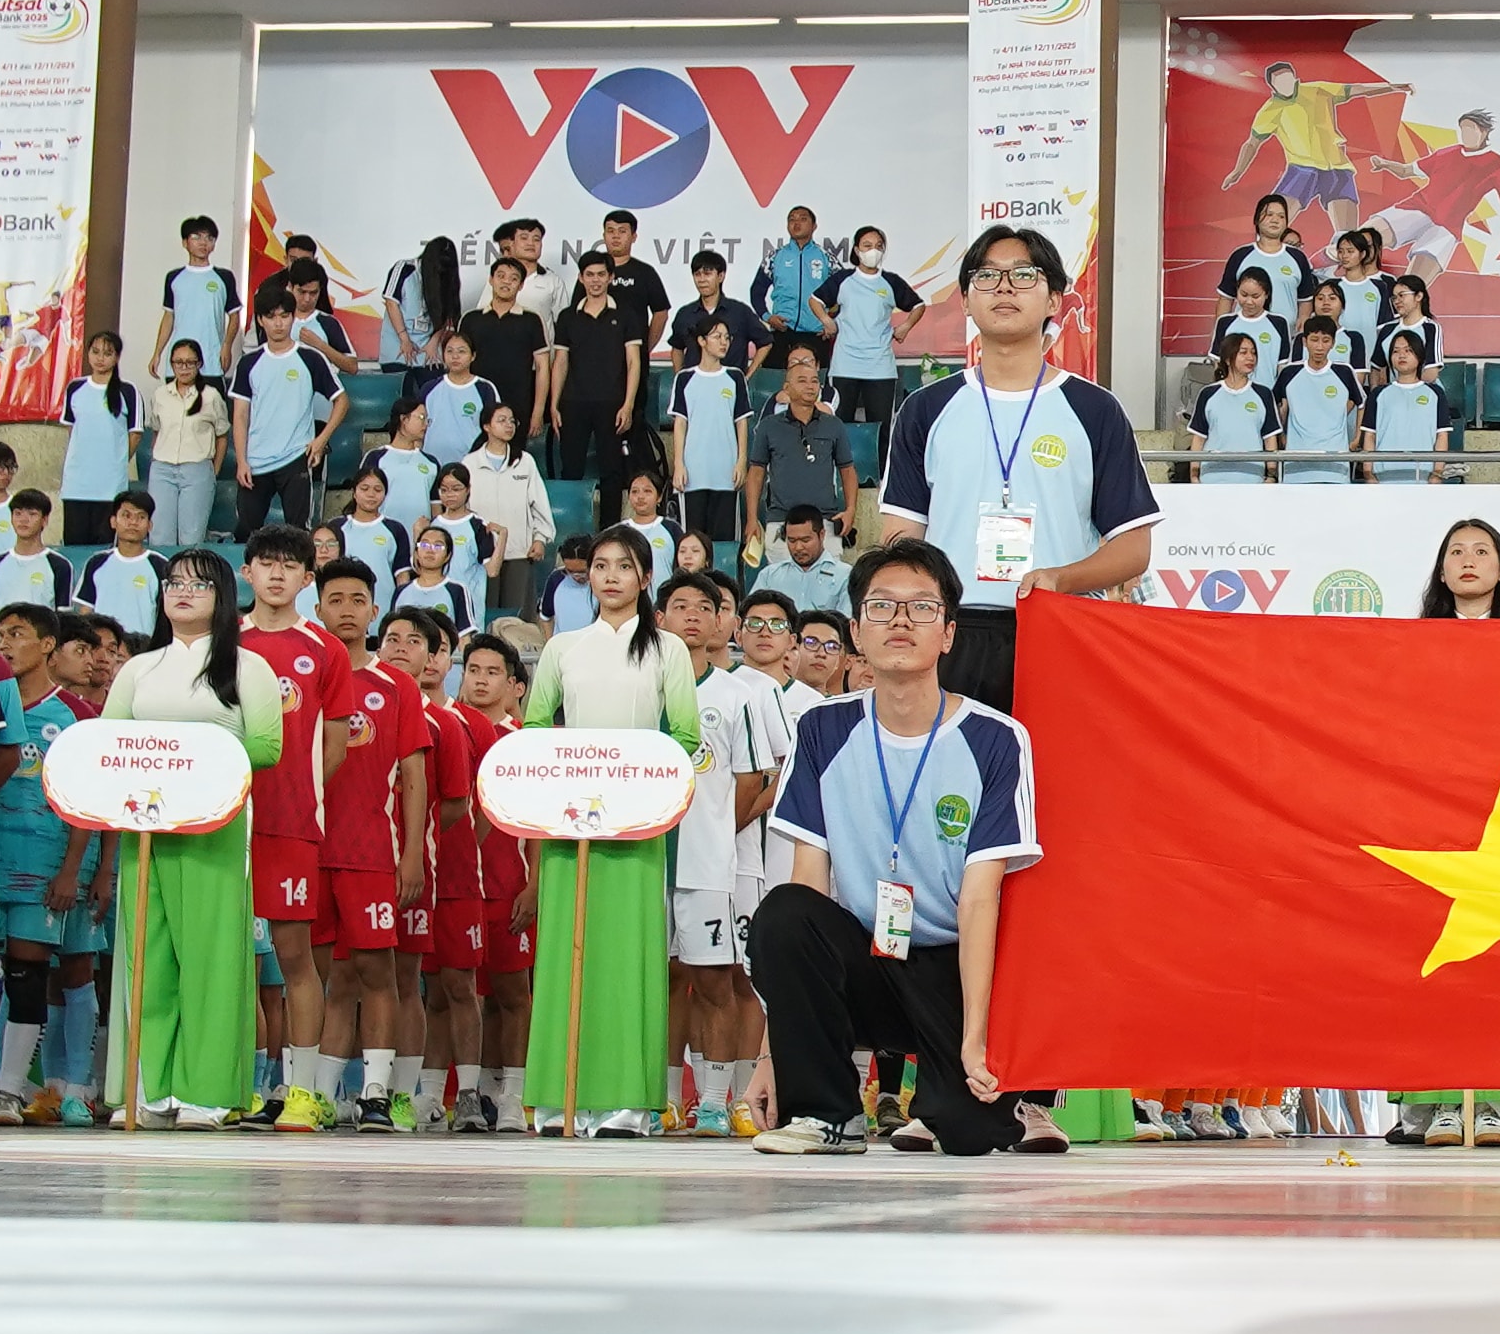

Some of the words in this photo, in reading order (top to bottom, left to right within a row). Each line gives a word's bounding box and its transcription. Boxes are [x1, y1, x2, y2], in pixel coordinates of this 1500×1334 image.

[25, 14, 48, 22] 2025
[429, 65, 855, 210] VOV
[981, 198, 1062, 220] HDBank
[1168, 544, 1198, 556] ĐƠN
[1201, 544, 1215, 559] VỊ
[1217, 542, 1235, 555] TỔ
[1238, 543, 1275, 555] CHỨC
[1157, 569, 1290, 613] VOV
[117, 735, 180, 751] TRƯỜNG
[554, 744, 621, 759] TRƯỜNG
[101, 755, 125, 771] ĐẠI
[130, 757, 163, 772] HỌC
[168, 759, 193, 771] FPT
[495, 766, 521, 781] ĐẠI
[526, 766, 560, 781] HỌC
[565, 766, 603, 778] RMIT
[607, 763, 640, 782] VIỆT
[643, 767, 678, 778] NAM
[280, 877, 307, 907] 14
[365, 902, 394, 929] 13
[705, 919, 723, 946] 7
